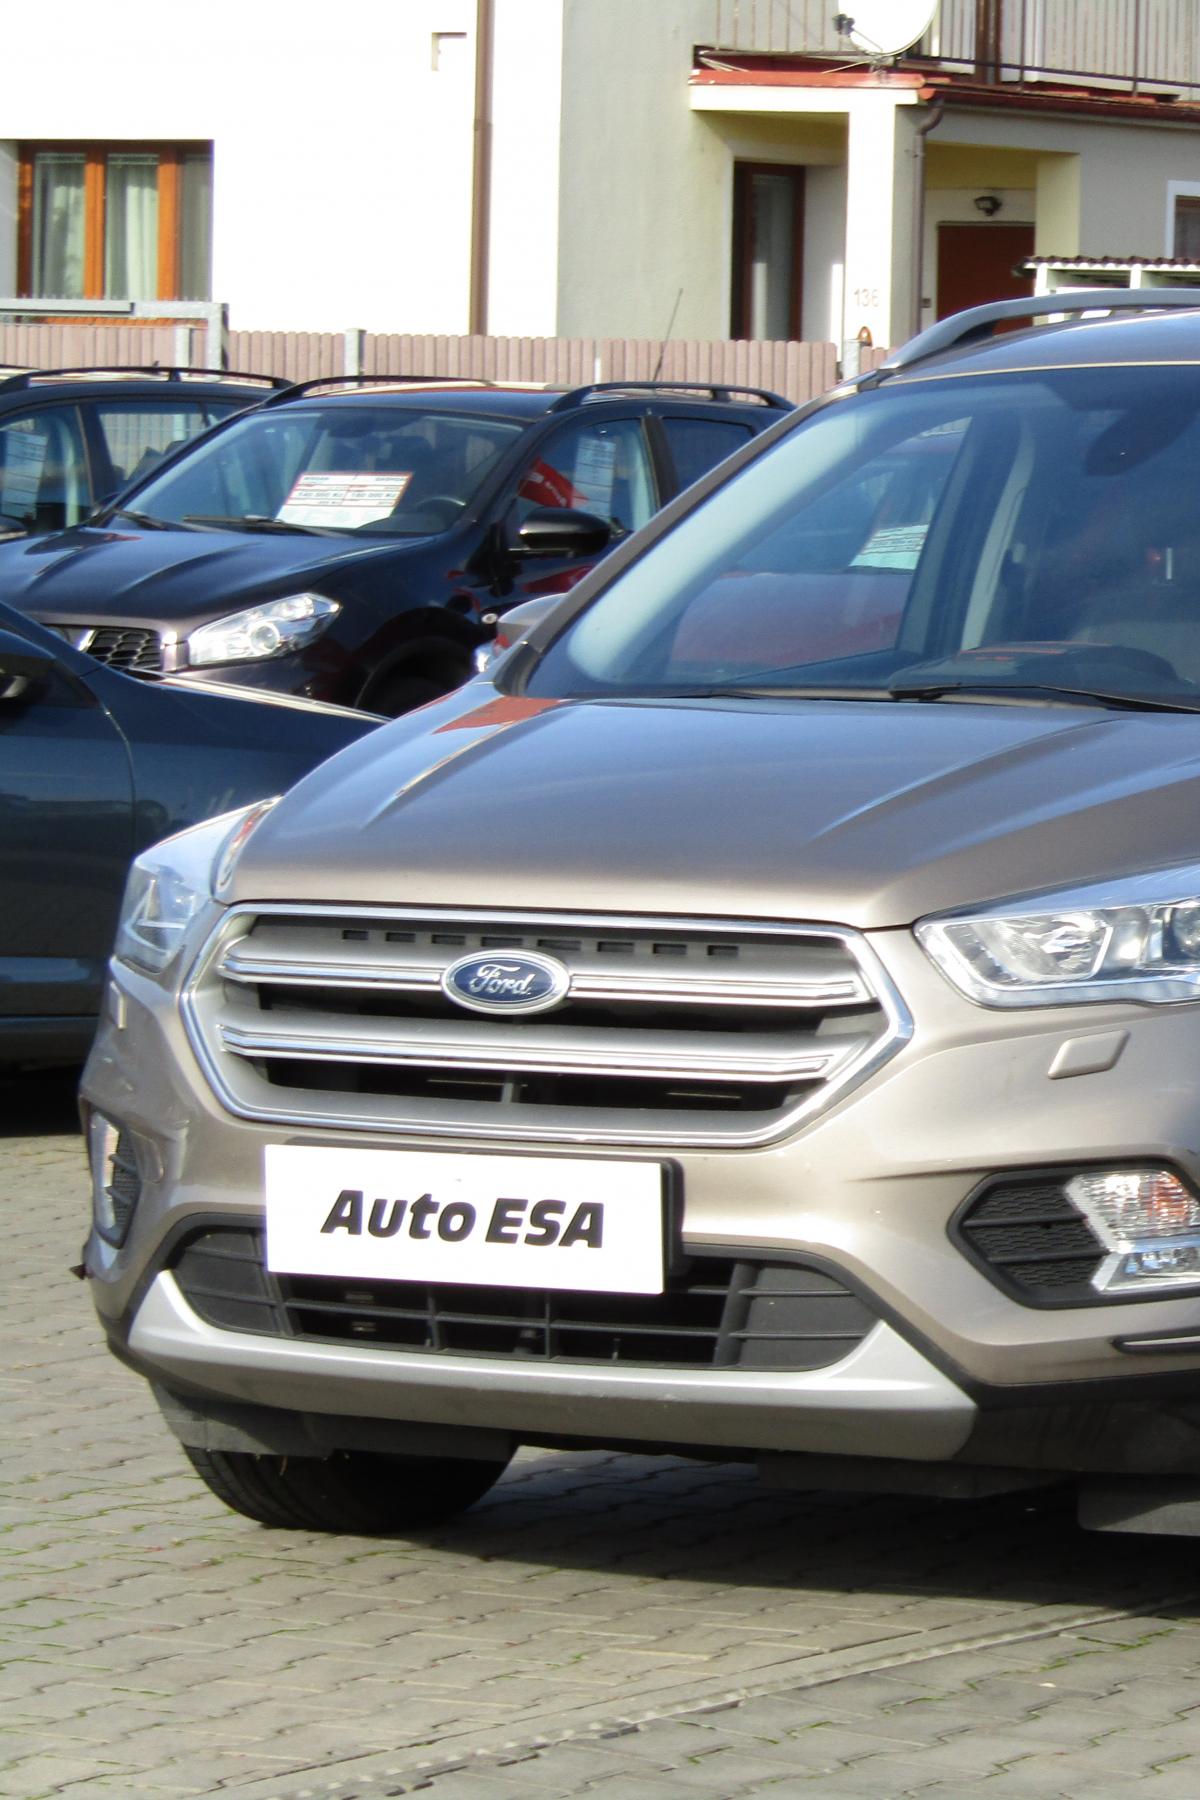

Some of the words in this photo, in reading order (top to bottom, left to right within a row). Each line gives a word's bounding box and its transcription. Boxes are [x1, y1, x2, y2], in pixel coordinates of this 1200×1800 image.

[469, 963, 536, 995] Ford
[320, 1189, 477, 1243] Auto
[485, 1197, 604, 1249] ESA
